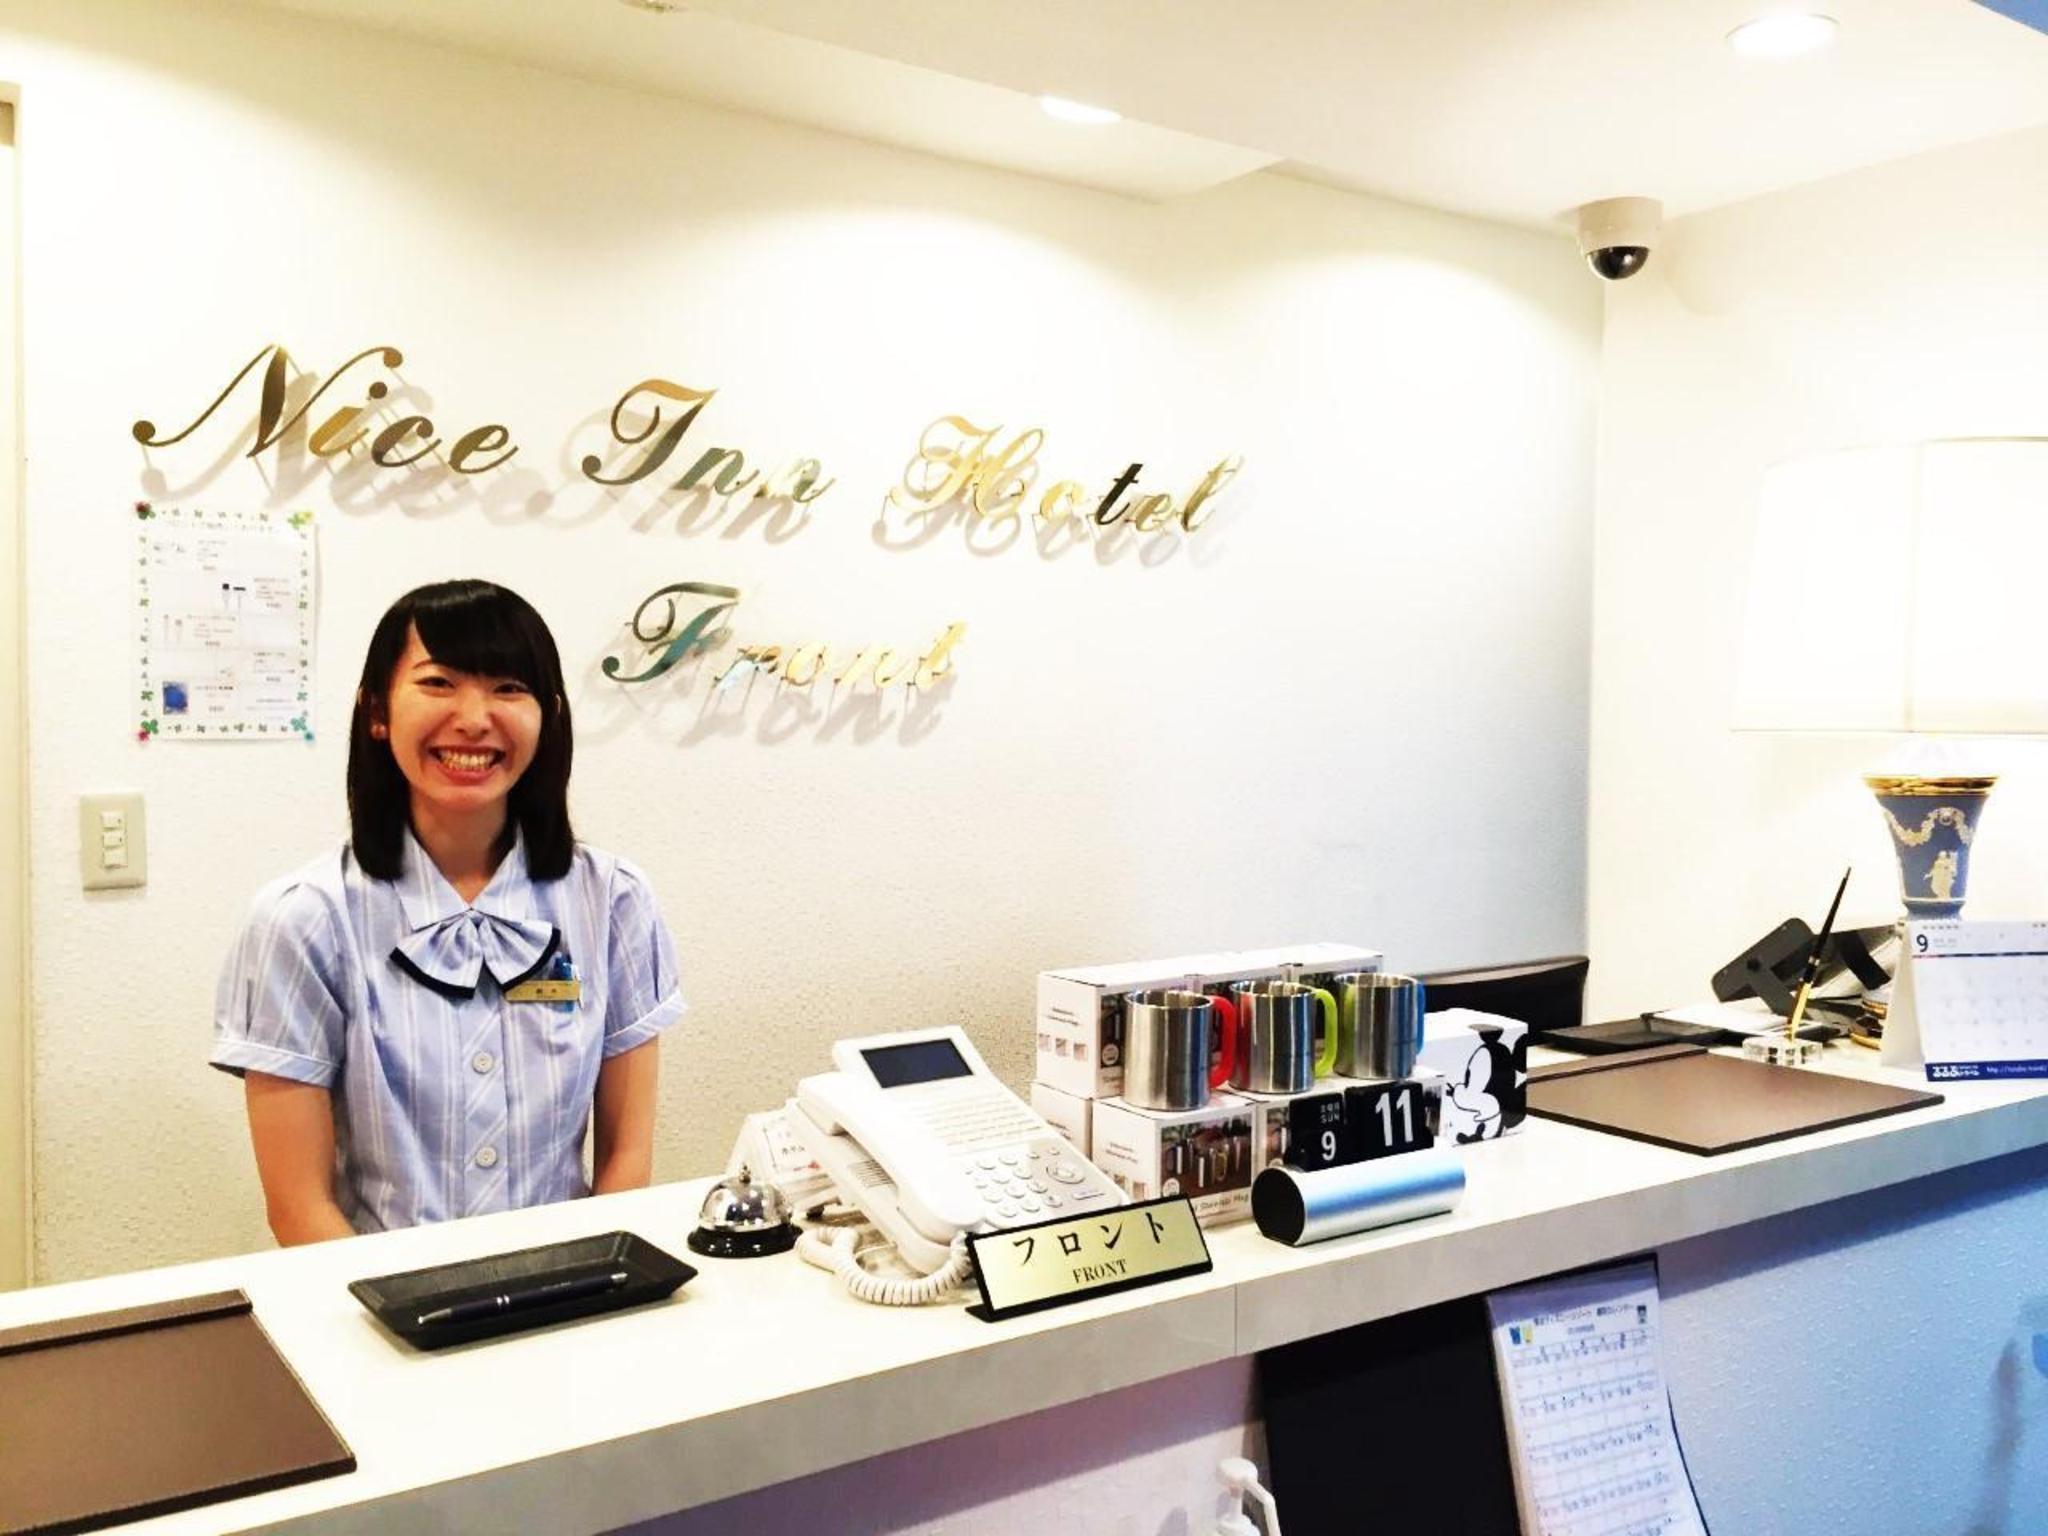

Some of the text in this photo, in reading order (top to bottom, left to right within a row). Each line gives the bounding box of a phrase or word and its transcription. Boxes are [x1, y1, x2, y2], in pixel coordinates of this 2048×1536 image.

[133, 344, 1244, 532] Nice Inn Hotel
[602, 582, 967, 688] Front
[1916, 934, 1928, 952] 9
[1320, 1112, 1340, 1124] SUN
[1375, 1089, 1414, 1146] 11
[1321, 1130, 1336, 1161] 9
[1012, 1211, 1165, 1266] フロント
[1073, 1258, 1128, 1284] FRONT
